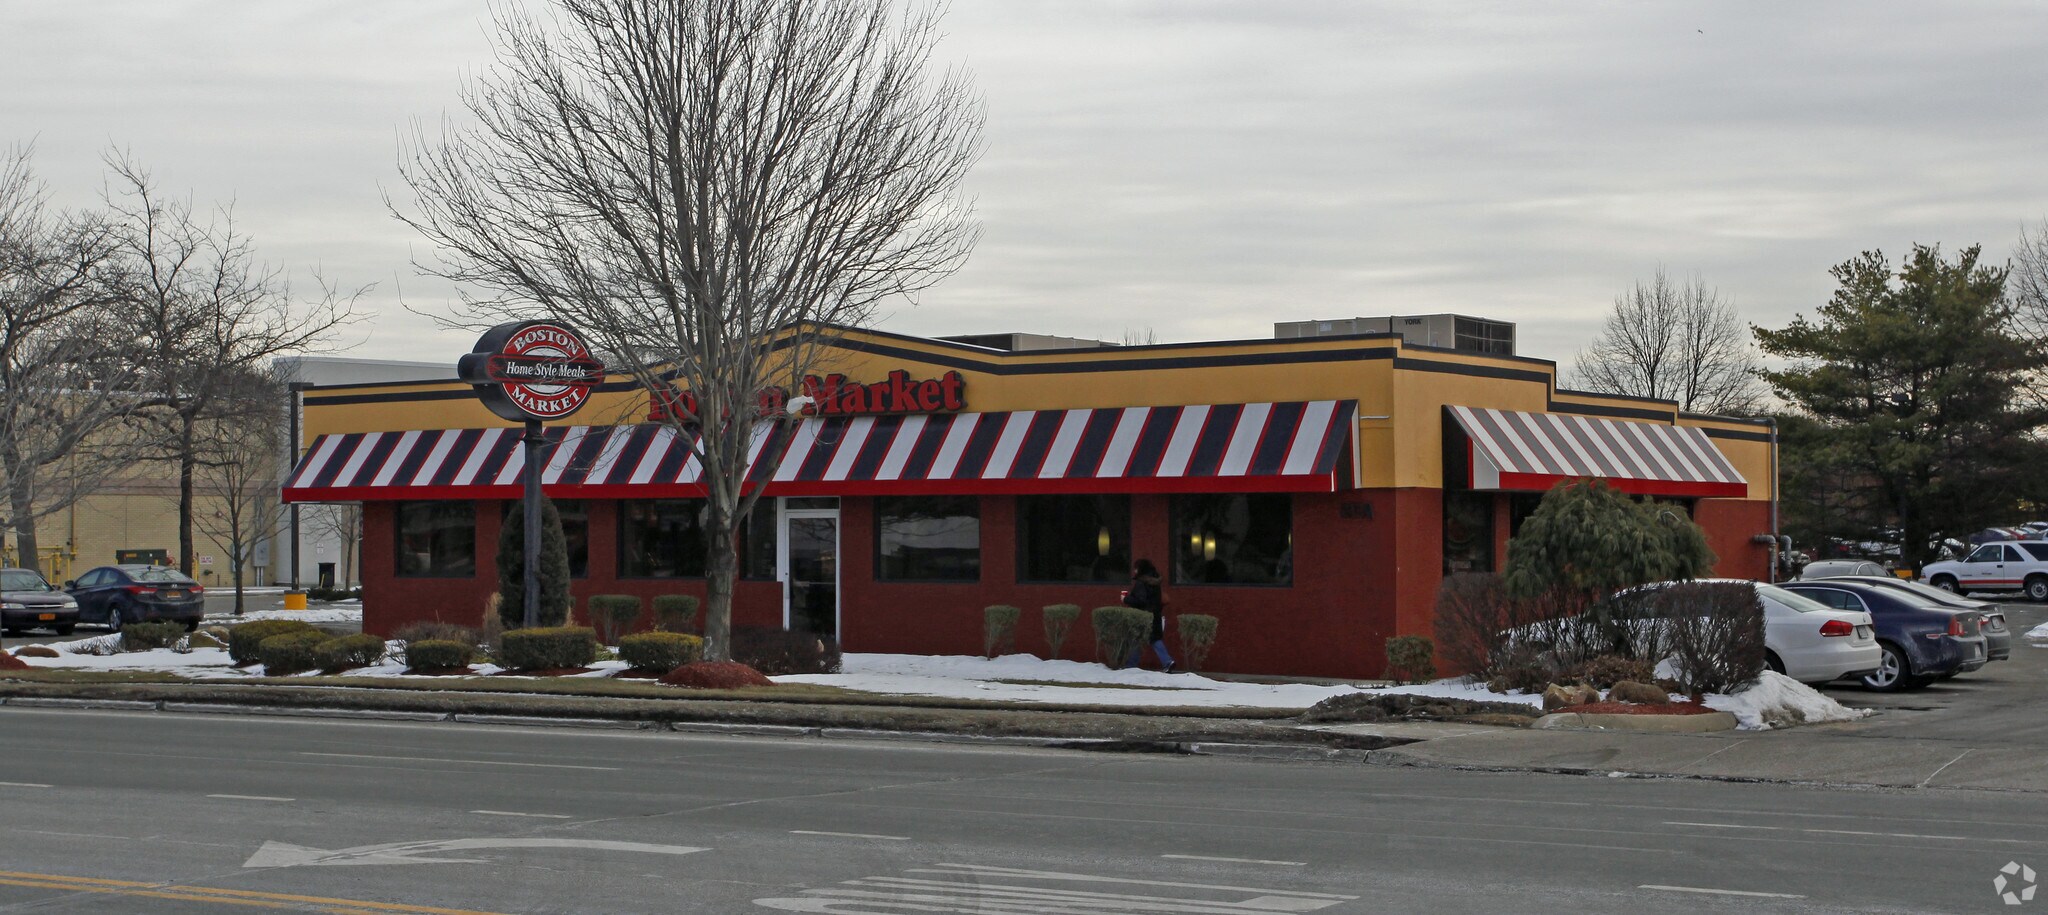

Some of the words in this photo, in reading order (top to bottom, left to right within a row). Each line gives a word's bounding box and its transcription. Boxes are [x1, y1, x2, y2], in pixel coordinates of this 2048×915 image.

[513, 329, 579, 355] BOSTON
[506, 361, 534, 375] Home
[535, 363, 557, 378] Style
[559, 364, 586, 377] Meals
[512, 387, 581, 412] MARKET
[801, 370, 961, 415] Market
